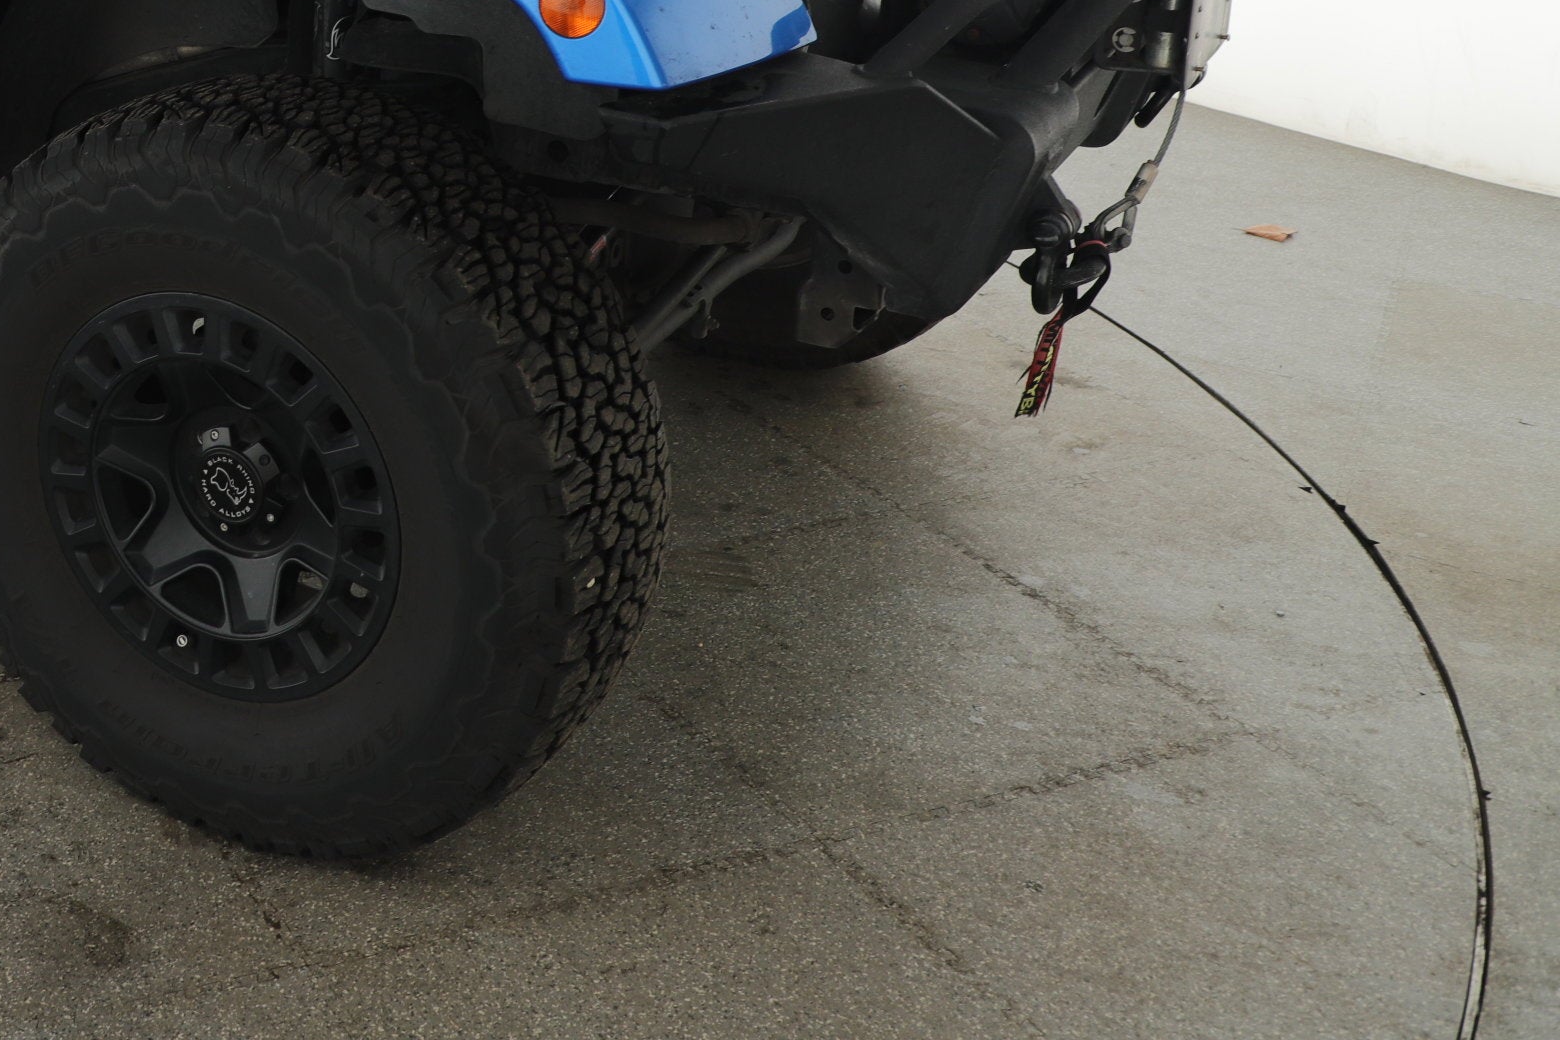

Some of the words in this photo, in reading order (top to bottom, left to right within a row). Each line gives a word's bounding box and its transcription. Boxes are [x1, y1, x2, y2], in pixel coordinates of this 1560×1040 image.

[207, 456, 233, 466] BLACK
[236, 464, 255, 494] RHINO
[202, 479, 216, 507] HARD
[219, 505, 251, 518] ALLOYS
